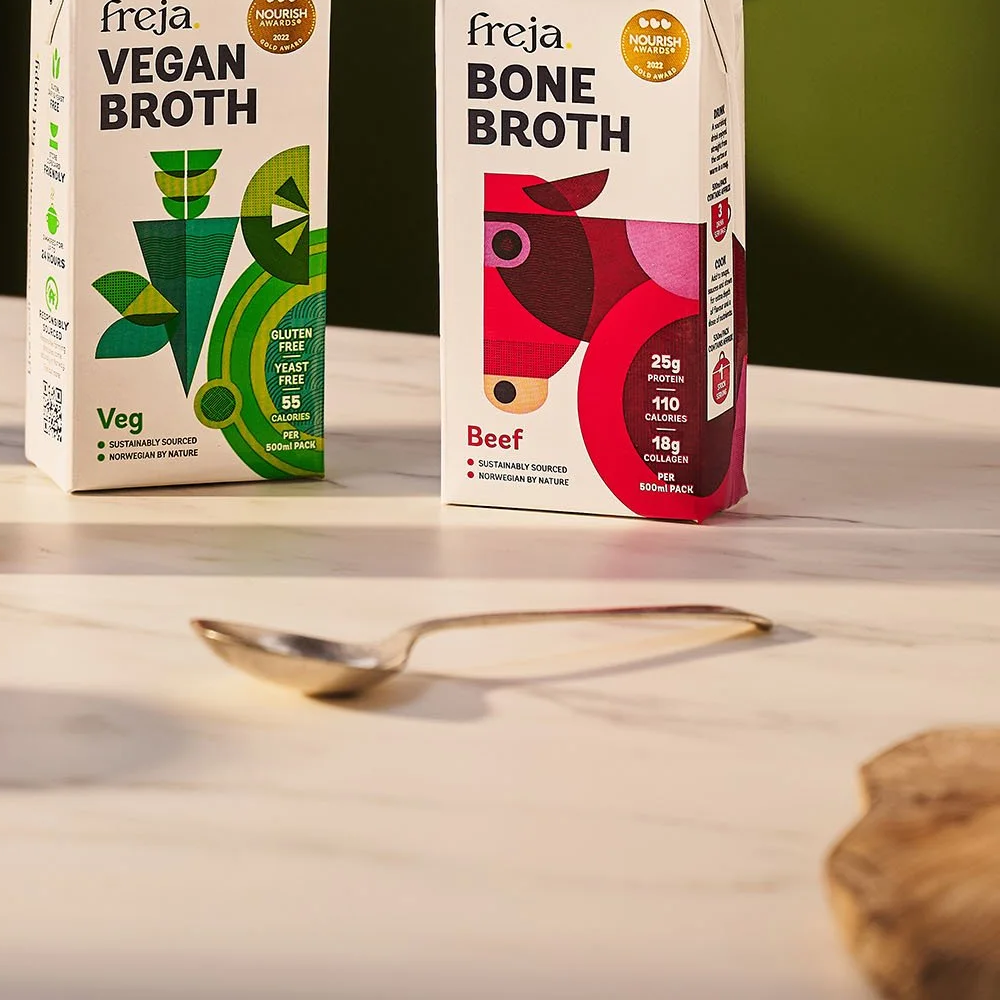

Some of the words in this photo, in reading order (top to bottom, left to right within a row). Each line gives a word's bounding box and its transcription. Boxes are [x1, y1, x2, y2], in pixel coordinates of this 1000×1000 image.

[256, 8, 307, 19] NOURISH
[260, 39, 277, 51] GOLD
[280, 38, 303, 51] AWARD
[629, 34, 681, 48] NOURISH
[98, 44, 246, 84] VEGAN
[647, 61, 663, 69] 2022
[634, 65, 651, 78] GOLD
[653, 67, 677, 79] AWARD
[468, 63, 595, 104] BONE
[100, 88, 256, 130] BROTH
[468, 109, 630, 152] BROTH
[717, 203, 722, 218] 3
[714, 255, 726, 270] COOK
[39, 310, 69, 331] RESPONSIBLY
[271, 328, 312, 340] GLUTEN
[279, 340, 304, 352] FREE
[274, 362, 309, 374] YEAST
[651, 355, 681, 373] 25g
[278, 374, 304, 386] FREE
[647, 375, 685, 384] PROTEIN
[282, 395, 300, 409] 55
[652, 397, 680, 411] 110
[97, 408, 143, 434] Veg
[271, 412, 310, 422] CALORIES
[645, 413, 687, 423] CALORIES
[283, 430, 299, 440] PER
[467, 425, 523, 450] Beef
[109, 438, 160, 448] SUSTAINABLY
[162, 436, 197, 446] SOURCED
[266, 442, 292, 452] 500ml
[294, 440, 316, 450] PACK
[652, 436, 680, 454] 18g
[109, 450, 155, 460] NORWEGIAN
[157, 450, 167, 459] BY
[168, 449, 198, 458] NATURE
[644, 454, 689, 463] COLLAGEN
[478, 459, 530, 471] SUSTAINABLY
[532, 463, 567, 474] SOURCED
[478, 472, 525, 483] NORWEGIAN
[527, 474, 537, 483] BY
[539, 475, 569, 486] NATURE
[658, 472, 674, 482] PER
[639, 483, 668, 493] 500ml
[670, 484, 694, 494] PACK
